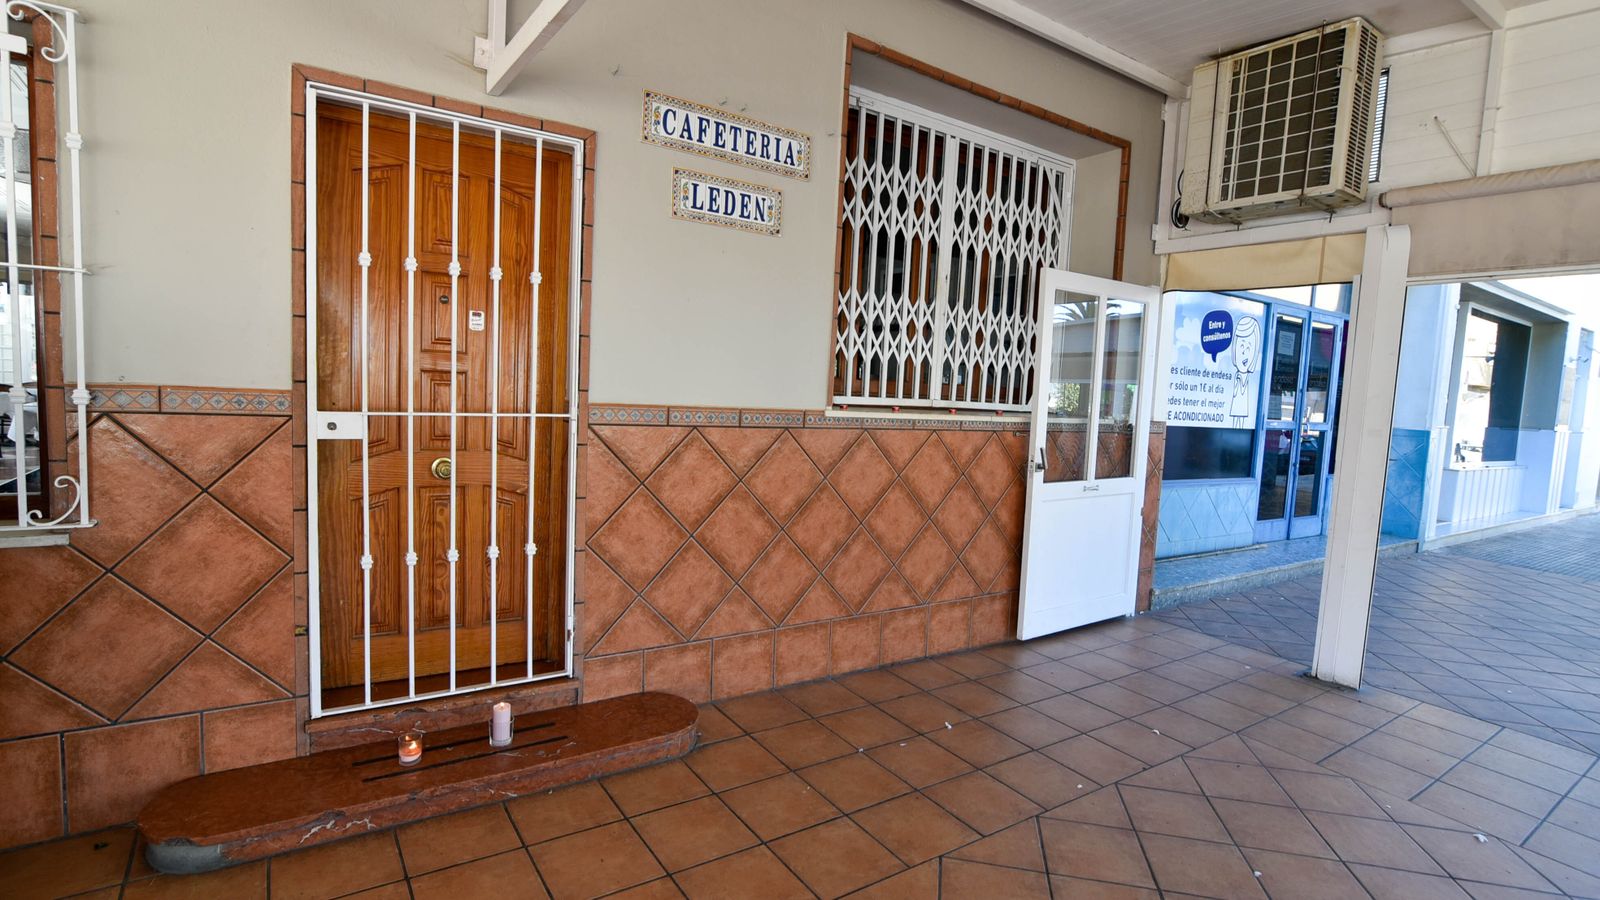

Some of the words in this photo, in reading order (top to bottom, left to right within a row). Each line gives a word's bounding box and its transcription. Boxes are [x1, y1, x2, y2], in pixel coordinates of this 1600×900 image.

[662, 108, 796, 166] CAFETERIA
[690, 182, 766, 222] LEDEN
[1208, 320, 1222, 330] Entre
[1180, 366, 1201, 377] cliente
[1202, 368, 1210, 378] de
[1210, 370, 1232, 380] endesa
[1174, 380, 1188, 391] sólo
[1200, 383, 1207, 392] 1€
[1208, 384, 1214, 393] al
[1214, 384, 1224, 394] día
[1182, 398, 1200, 407] tener
[1200, 398, 1207, 408] el
[1208, 399, 1225, 410] mejor
[1174, 412, 1225, 423] ACONDICIONADO
